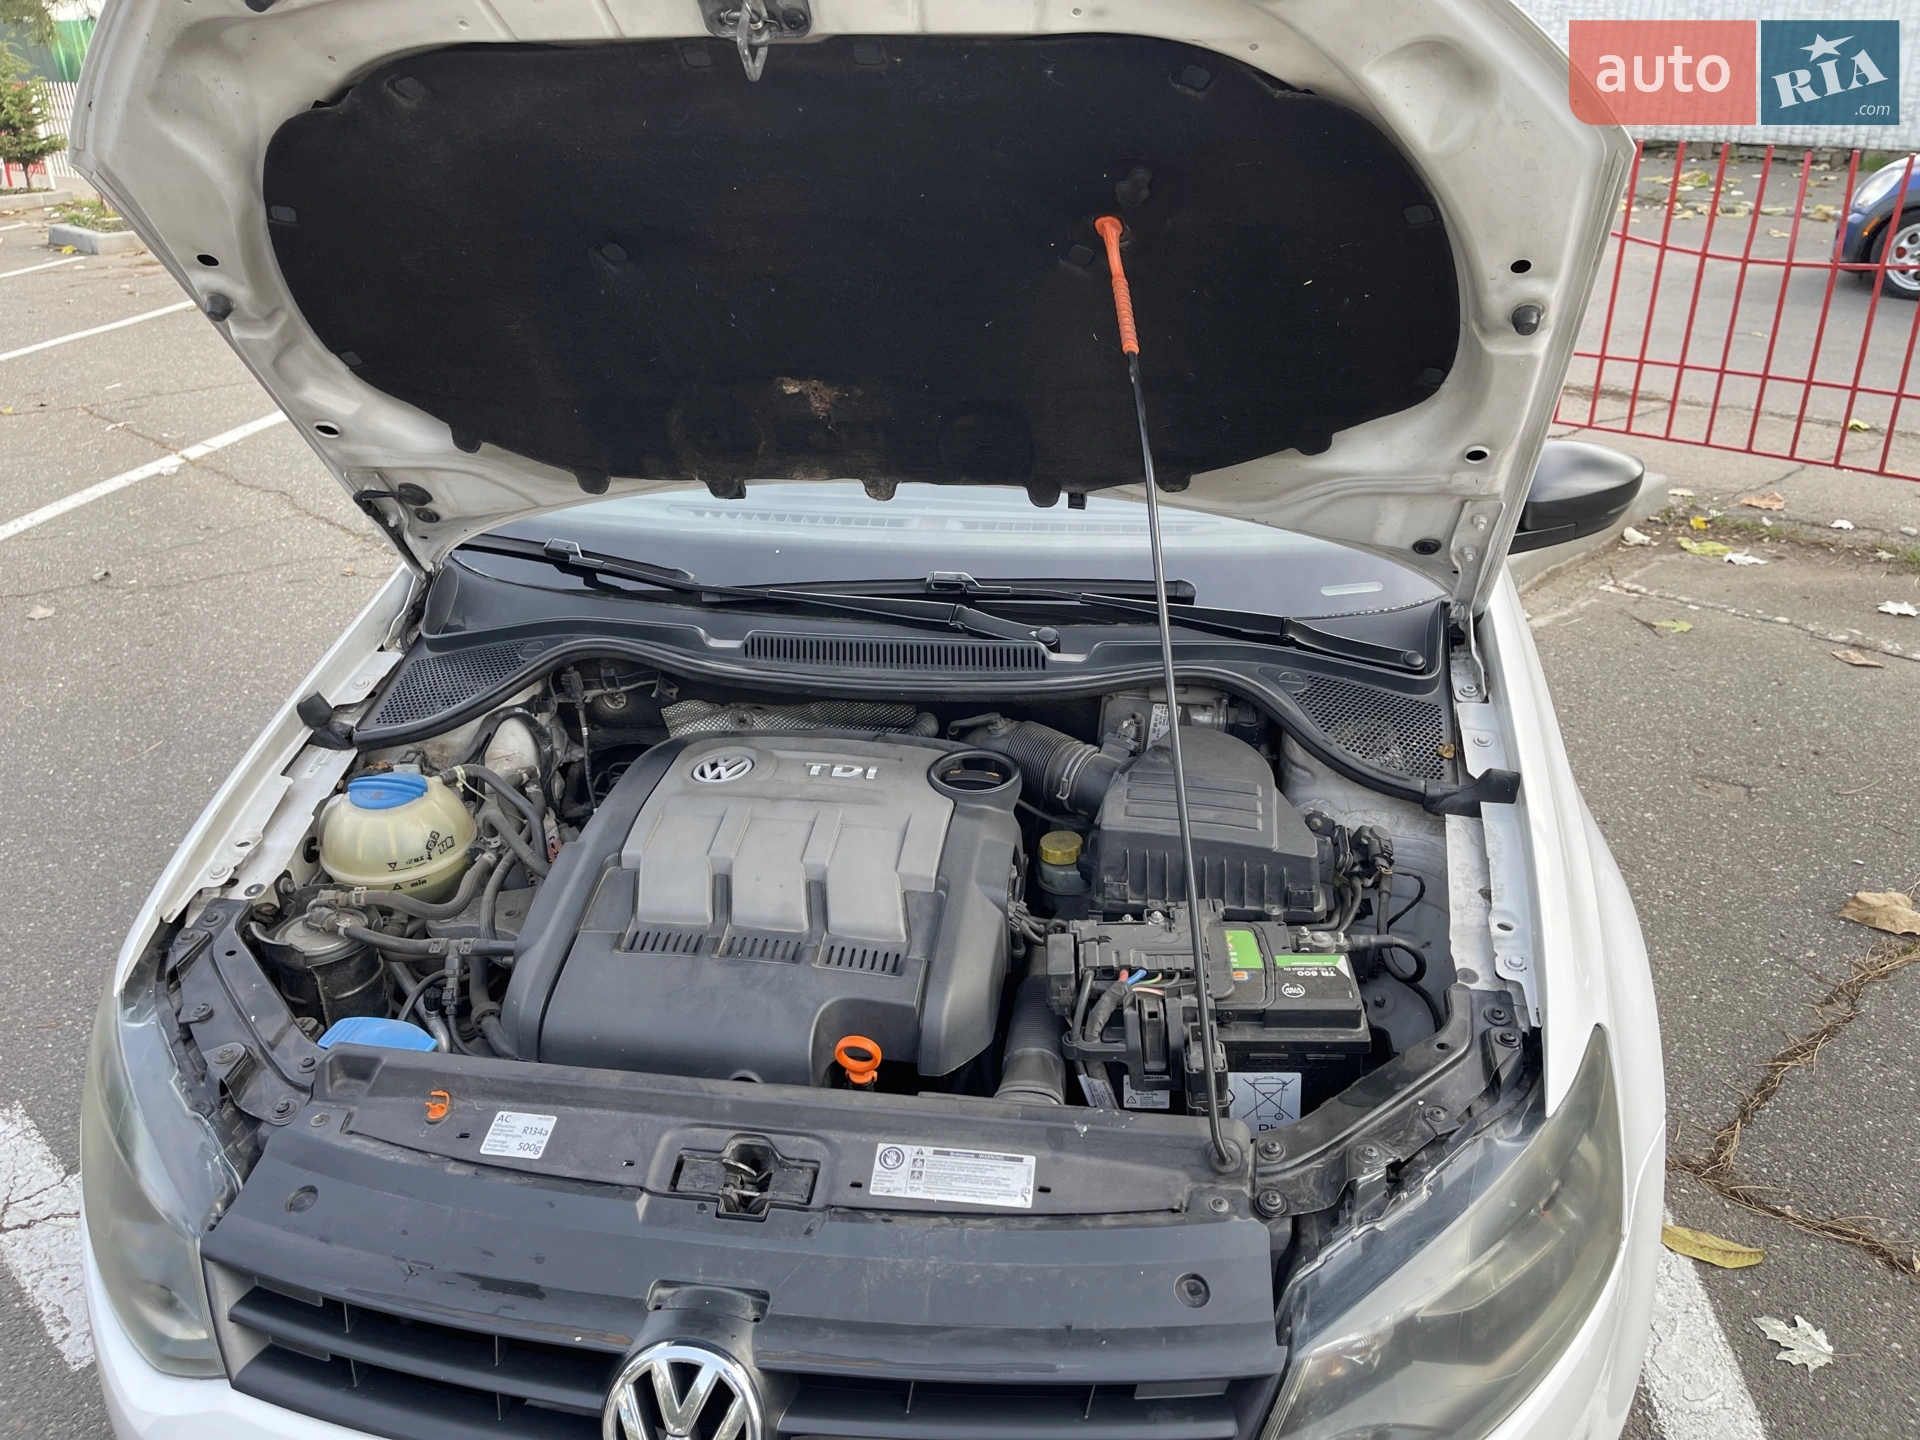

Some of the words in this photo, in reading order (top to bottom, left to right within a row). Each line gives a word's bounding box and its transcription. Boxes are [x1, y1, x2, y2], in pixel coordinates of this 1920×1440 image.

[692, 753, 754, 783] VW
[805, 762, 879, 780] TDI
[410, 879, 427, 888] min
[496, 1114, 512, 1123] AC
[521, 1126, 549, 1137] R134a
[516, 1142, 542, 1155] 500g
